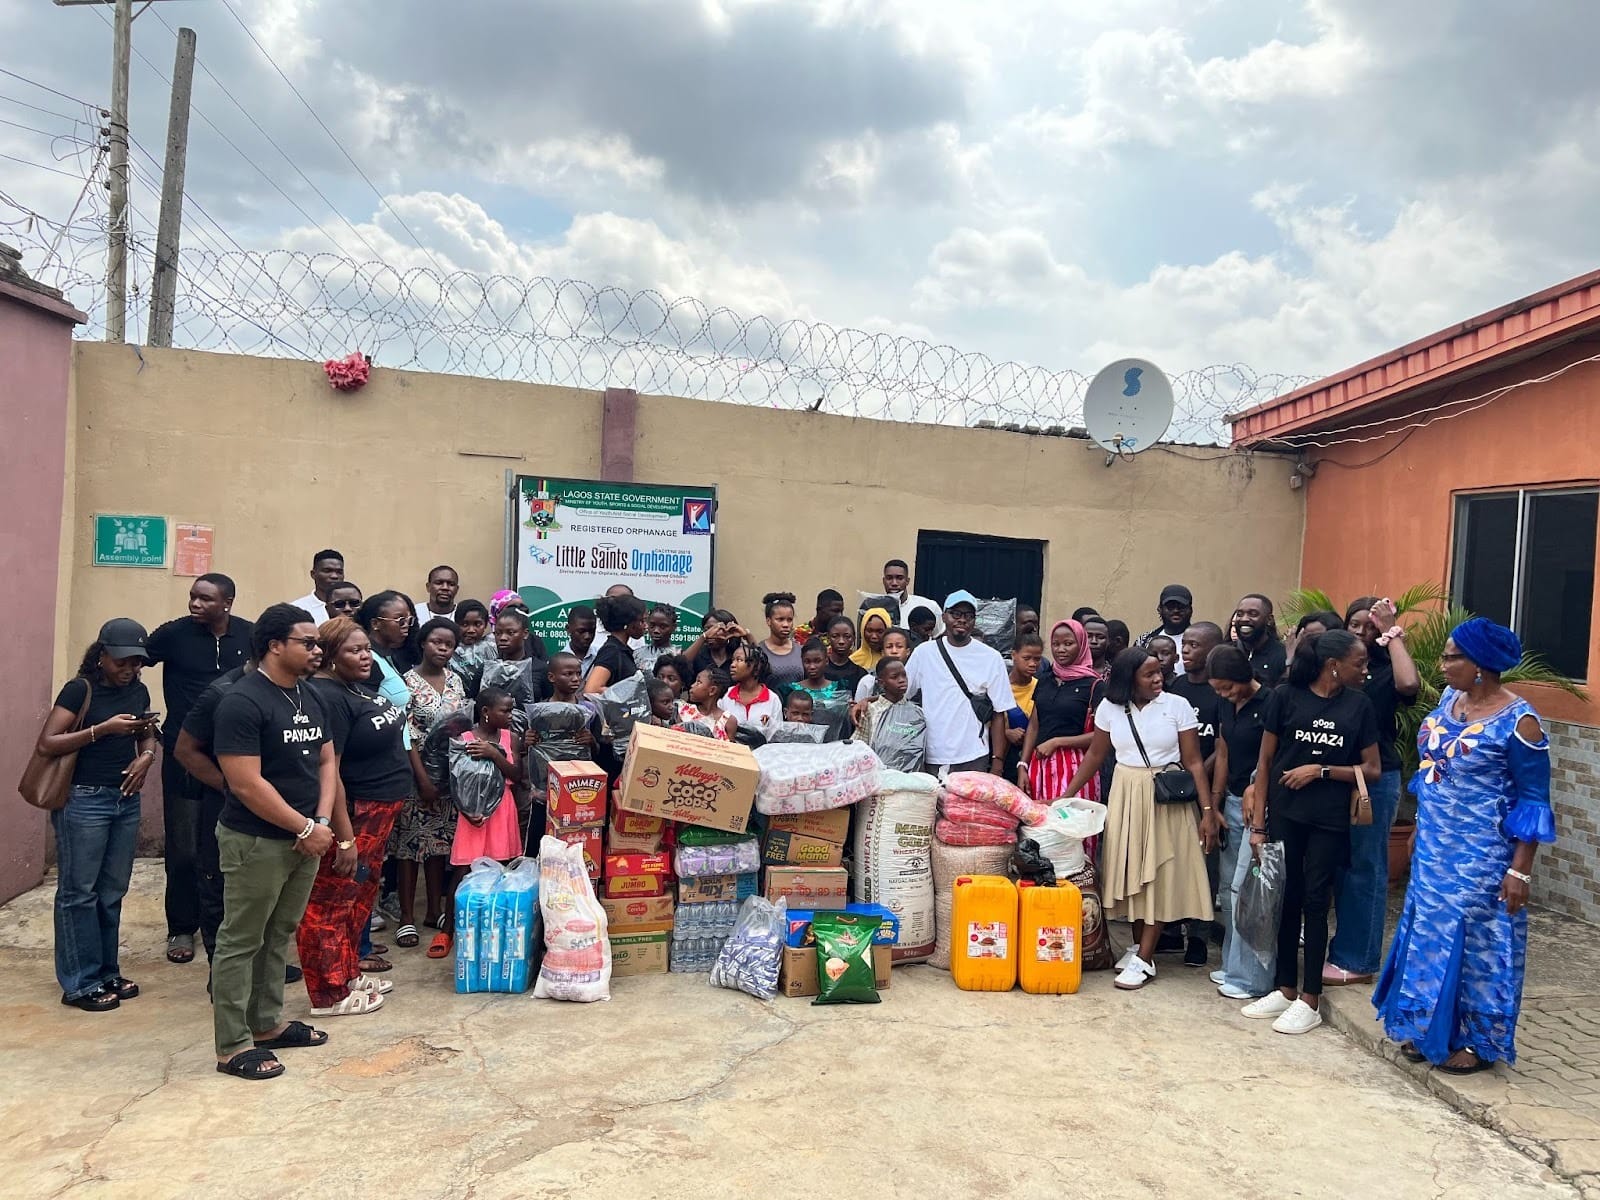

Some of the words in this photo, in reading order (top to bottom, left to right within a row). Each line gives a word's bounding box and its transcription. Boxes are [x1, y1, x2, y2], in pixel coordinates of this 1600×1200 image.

[563, 490, 593, 499] LAGOS
[594, 492, 620, 501] STATE
[622, 494, 681, 504] GOVERNMENT
[570, 524, 624, 534] REGISTERED
[625, 528, 678, 537] ORPHANAGE
[99, 553, 139, 563] Assembly
[141, 555, 162, 563] point
[556, 545, 586, 568] Little
[591, 546, 628, 570] Saints
[631, 548, 693, 575] Orphanage
[1312, 719, 1336, 730] 2022
[283, 726, 322, 743] PAYAZA
[1295, 729, 1344, 747] PAYAZA
[674, 763, 720, 784] Kellogg's
[669, 783, 717, 802] COCO
[675, 796, 709, 809] pops
[866, 794, 879, 831] FLOUR
[800, 844, 829, 853] Good
[864, 834, 872, 874] WHEAT
[765, 851, 786, 861] FREE
[621, 881, 646, 889] JUMBO
[570, 937, 597, 950] SALT
